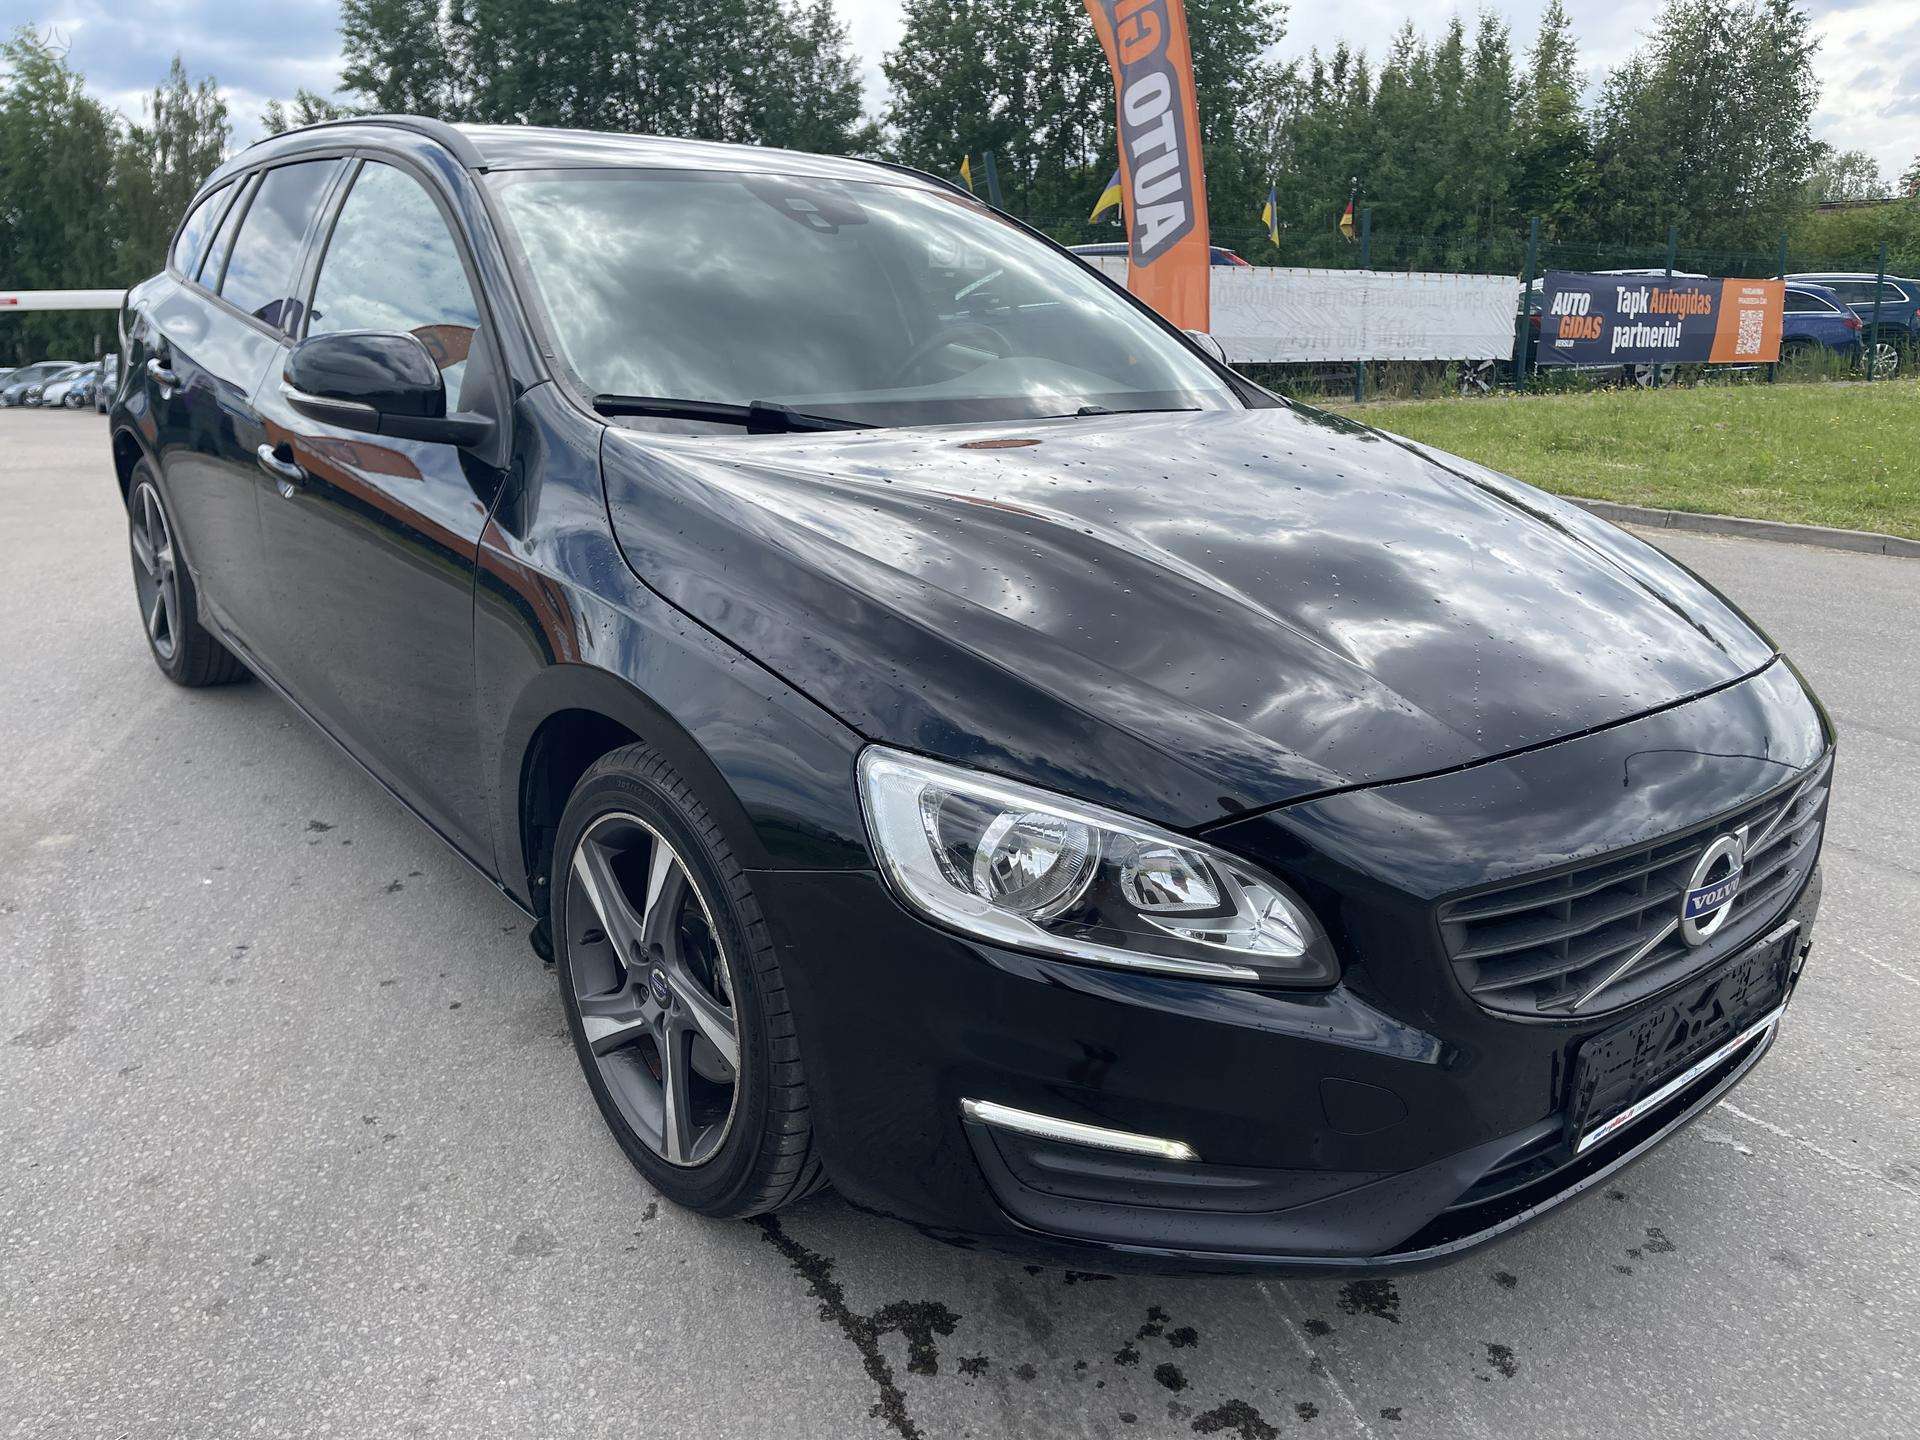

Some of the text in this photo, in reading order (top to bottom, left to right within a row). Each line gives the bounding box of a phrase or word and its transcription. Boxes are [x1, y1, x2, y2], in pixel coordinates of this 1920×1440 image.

[1551, 292, 1590, 316] AUTO
[1616, 286, 1712, 320] Tapk Autogidas
[1559, 316, 1602, 339] GIDAS
[1611, 320, 1682, 354] partneriu!
[1691, 877, 1740, 910] VOLVO
